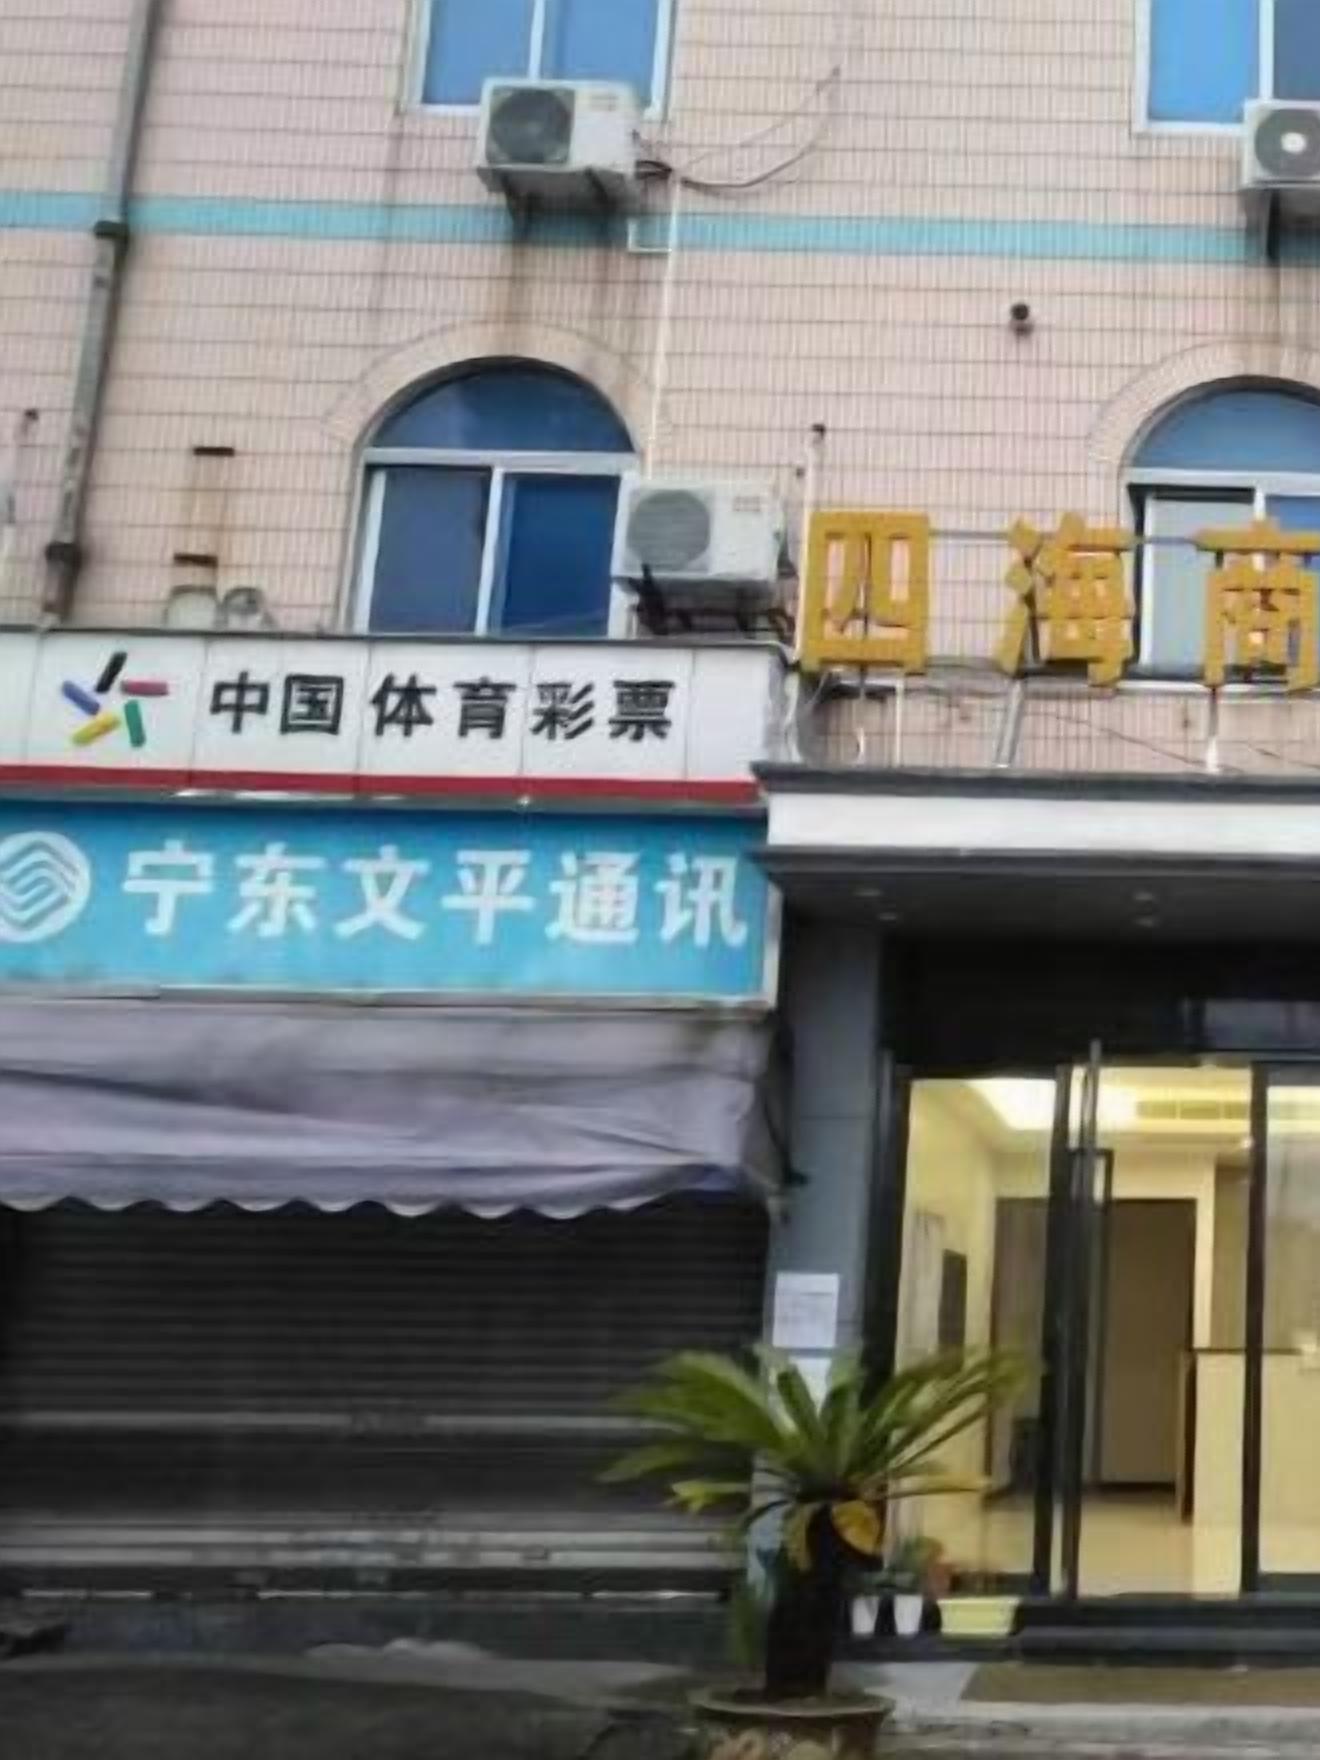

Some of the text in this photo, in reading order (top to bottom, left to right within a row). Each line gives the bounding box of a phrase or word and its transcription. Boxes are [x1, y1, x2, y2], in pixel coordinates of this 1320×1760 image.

[209, 670, 676, 742] 中国体育彩票
[121, 839, 749, 948] 宁东文平通讯
